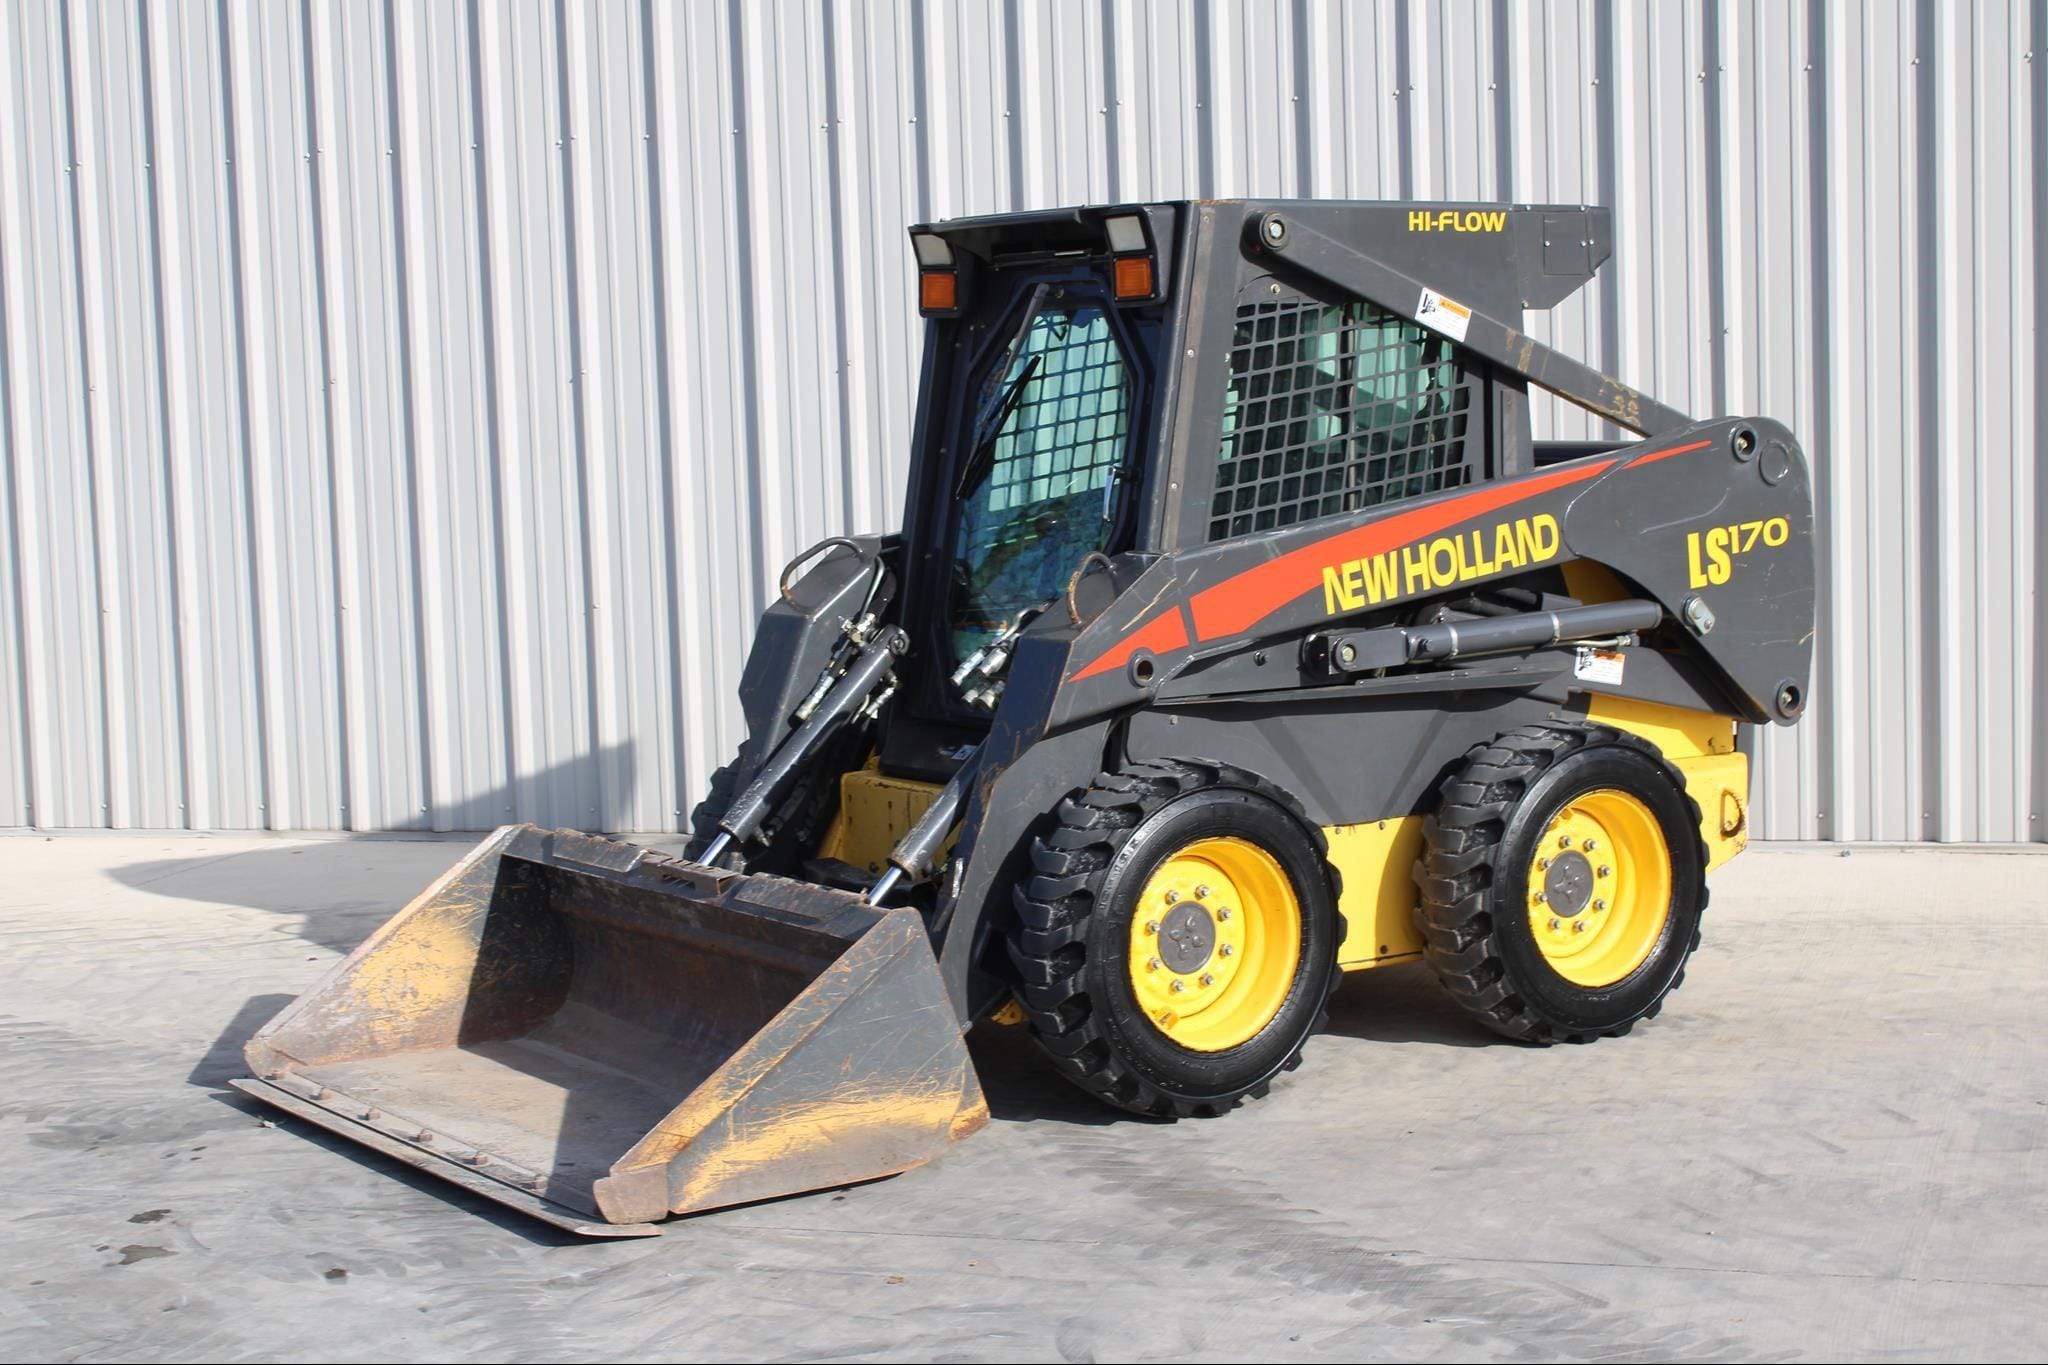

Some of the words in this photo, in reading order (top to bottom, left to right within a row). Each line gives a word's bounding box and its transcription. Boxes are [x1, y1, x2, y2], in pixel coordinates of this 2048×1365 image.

[1408, 211, 1507, 233] HI-FLOW
[1322, 551, 1399, 616] NEW
[1402, 513, 1560, 595] HOLLAND
